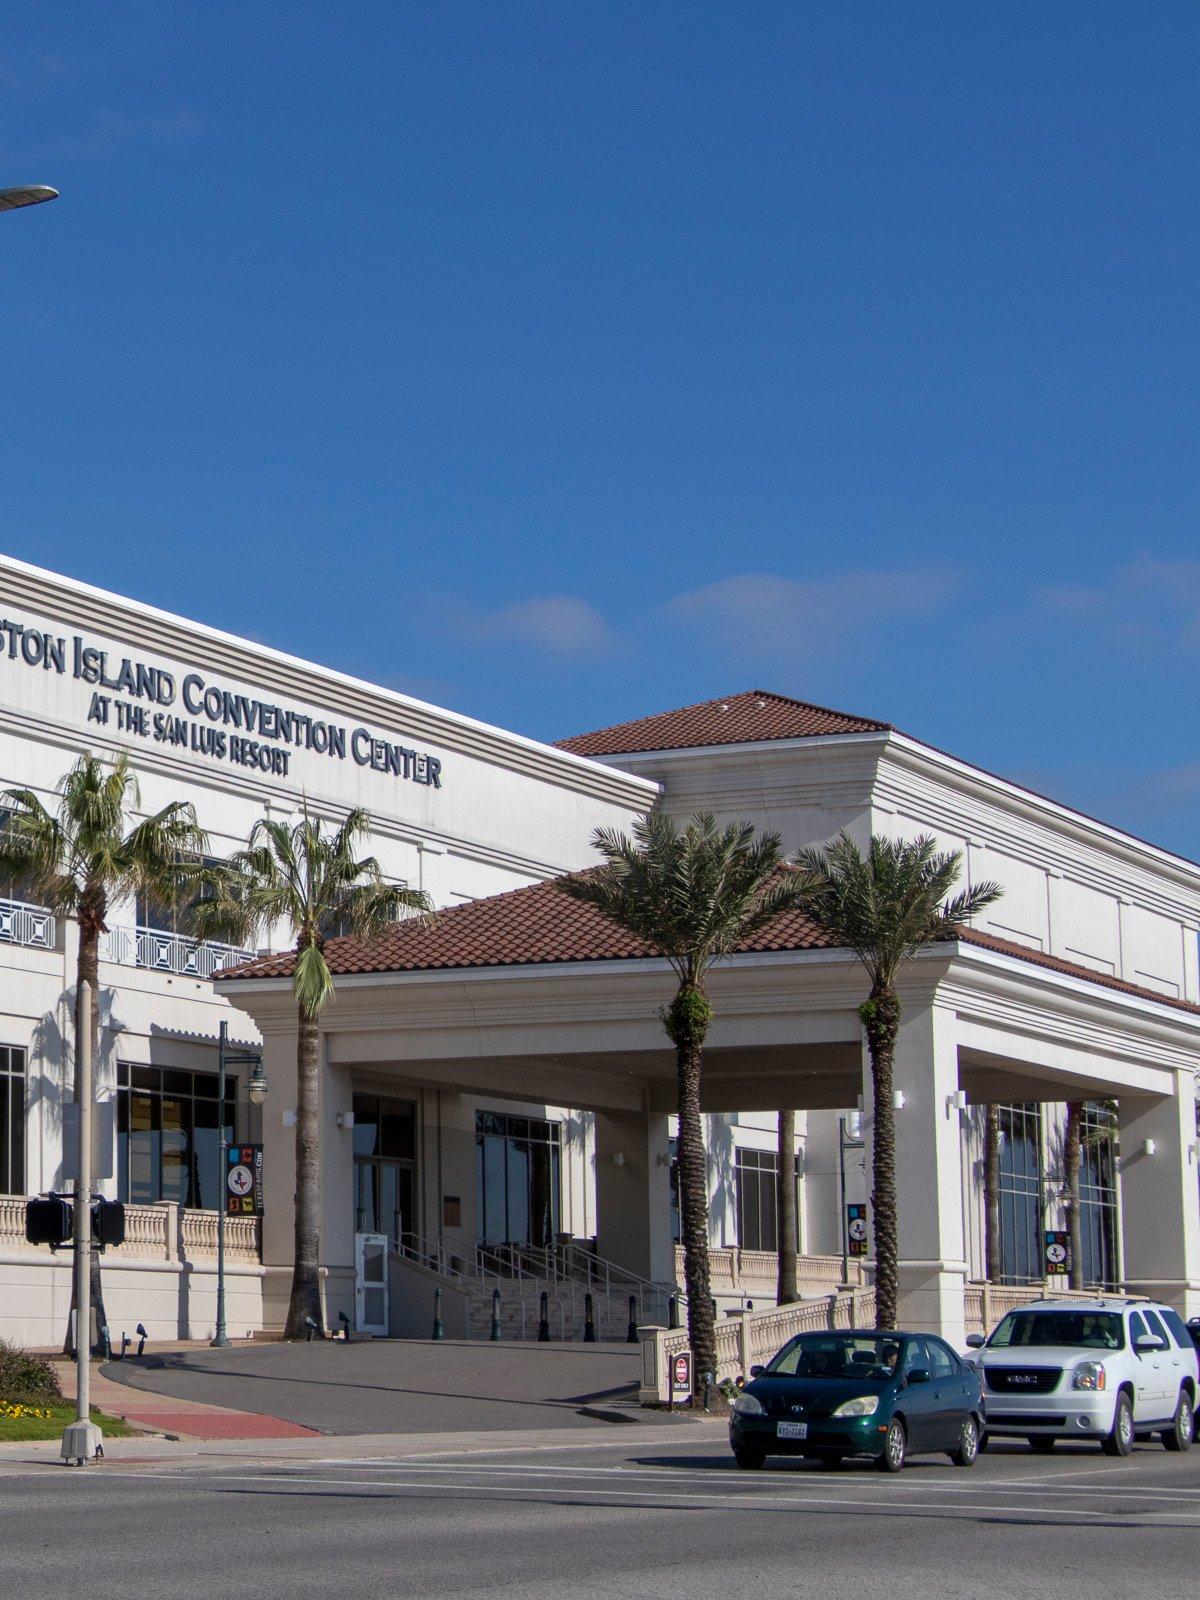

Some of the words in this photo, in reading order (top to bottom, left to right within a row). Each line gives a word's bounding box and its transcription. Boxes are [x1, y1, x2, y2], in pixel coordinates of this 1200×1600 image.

[73, 636, 177, 707] ISLAND
[183, 674, 346, 760] CONVENTION
[351, 728, 441, 789] CENTER
[87, 692, 111, 725] AT
[115, 700, 150, 737] THE
[153, 712, 188, 747] SAN
[191, 723, 227, 759] LUIS
[230, 735, 291, 777] RESORT
